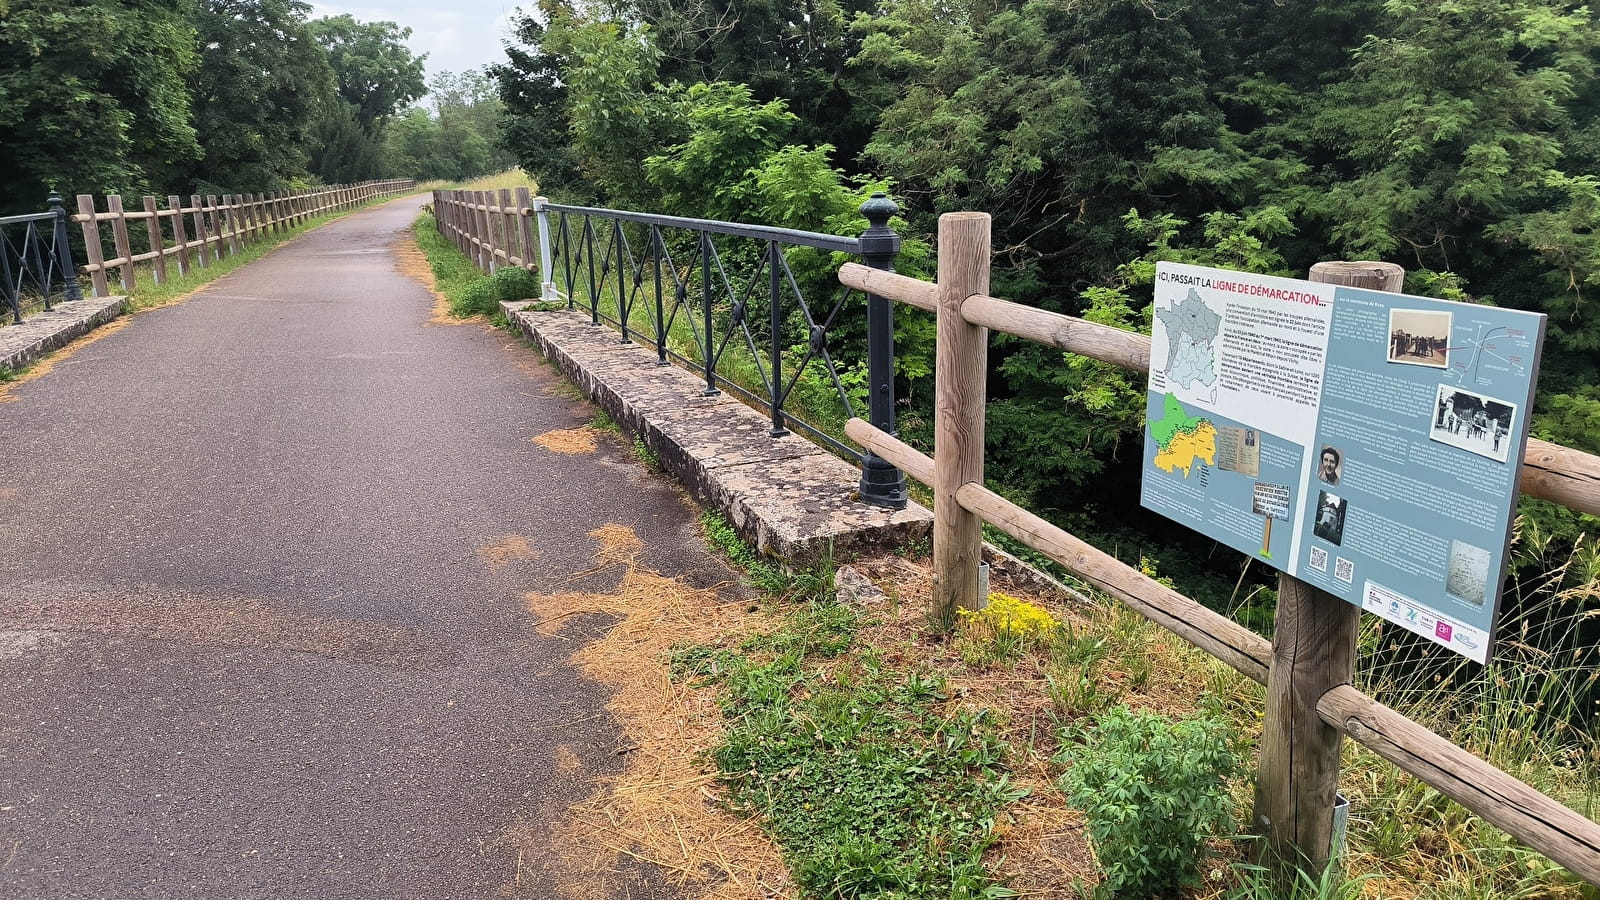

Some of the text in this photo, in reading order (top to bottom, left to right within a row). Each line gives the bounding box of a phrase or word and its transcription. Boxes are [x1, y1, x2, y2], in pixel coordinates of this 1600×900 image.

[1158, 271, 1170, 283] ICI,
[1170, 274, 1200, 288] PASSAIT
[1202, 279, 1211, 288] LA
[1212, 280, 1236, 293] LIGNE
[1238, 283, 1248, 294] DE
